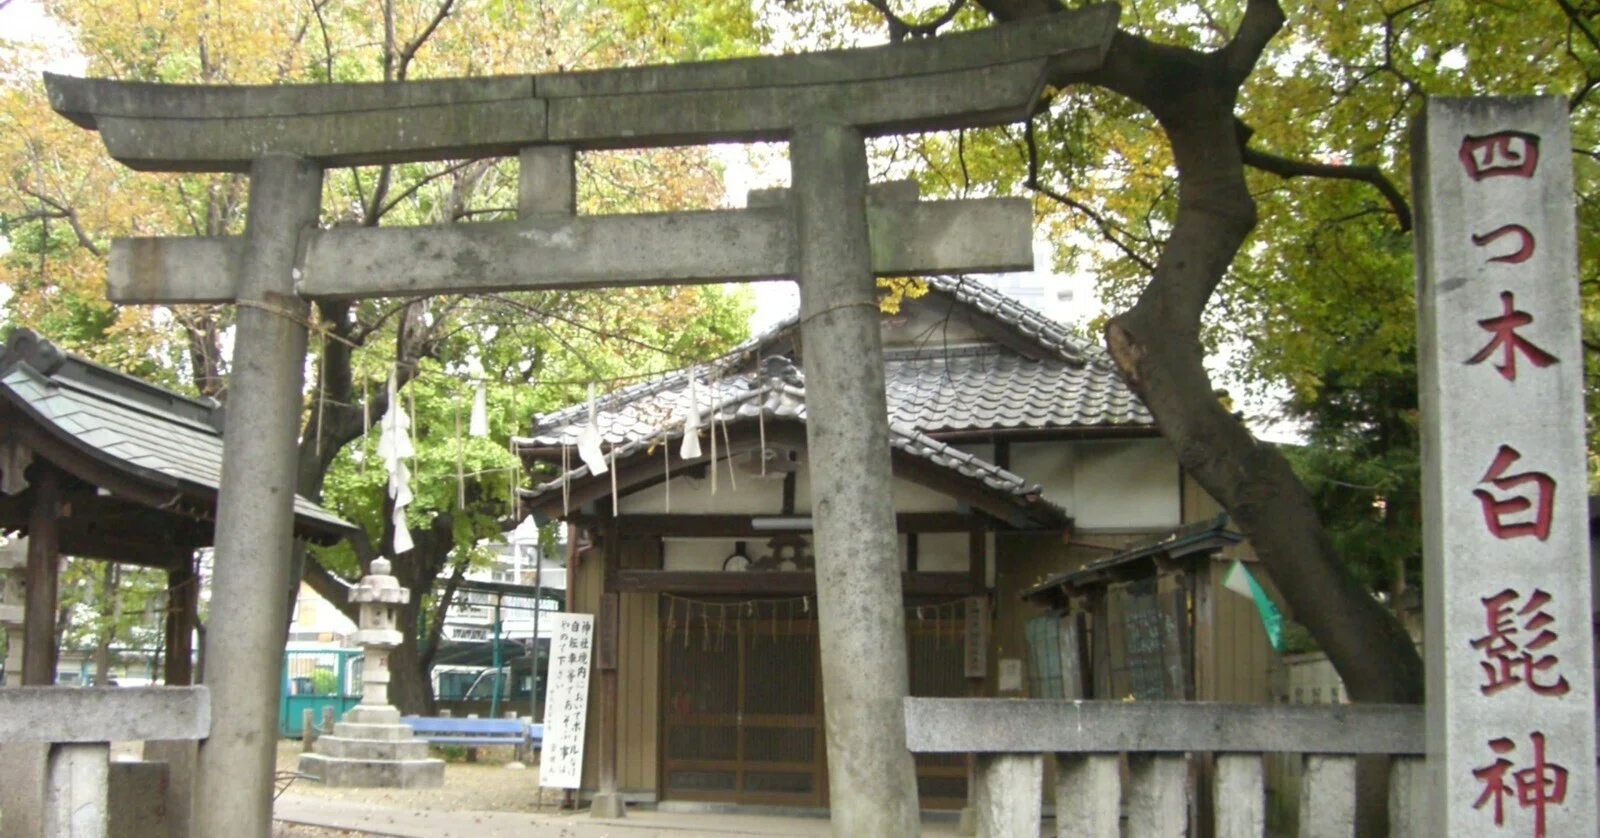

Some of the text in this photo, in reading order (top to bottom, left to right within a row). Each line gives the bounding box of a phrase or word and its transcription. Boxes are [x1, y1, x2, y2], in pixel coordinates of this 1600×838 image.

[1459, 131, 1571, 838] 四つ木白髭神
